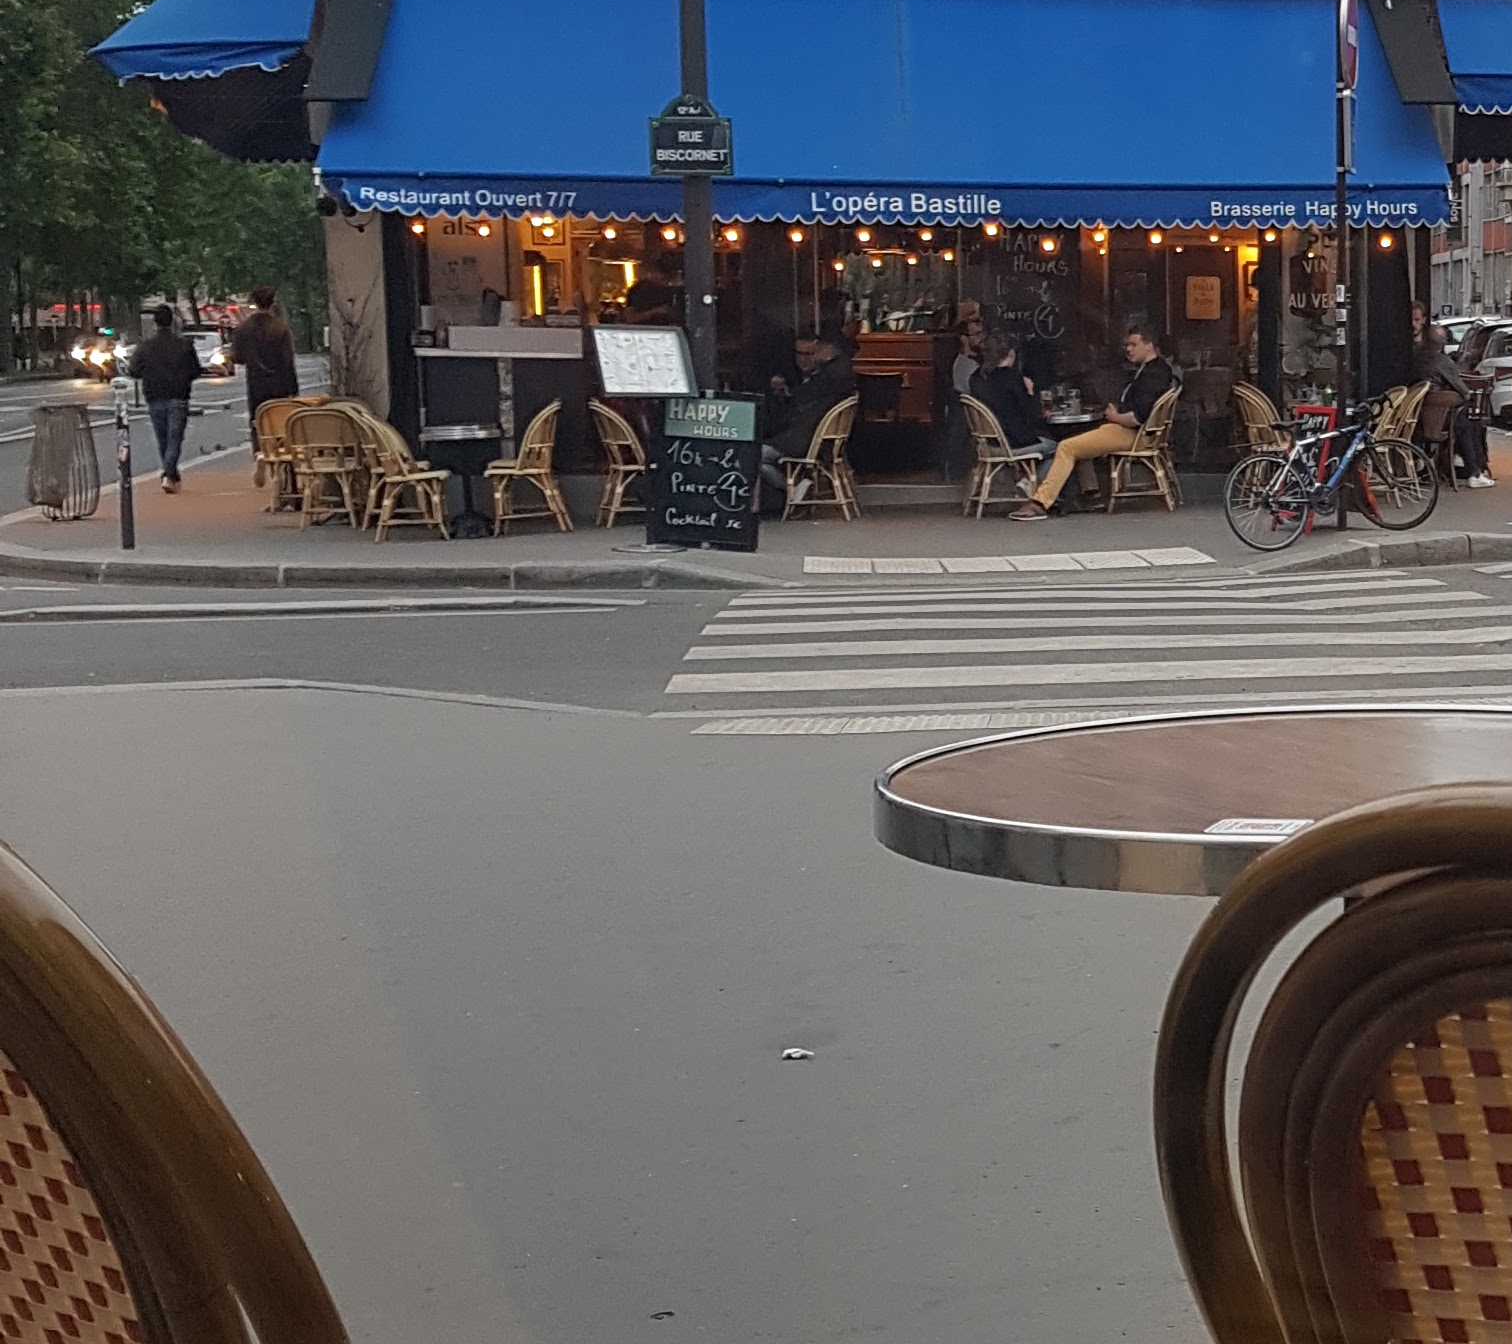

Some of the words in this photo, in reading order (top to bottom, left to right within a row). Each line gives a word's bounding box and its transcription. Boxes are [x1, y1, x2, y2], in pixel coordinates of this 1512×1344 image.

[678, 130, 704, 143] RUE
[656, 149, 729, 161] BISCORNET
[359, 186, 471, 206] Restaurant
[475, 189, 542, 207] Ouvert
[546, 191, 577, 207] 7/7
[811, 192, 903, 216] L'opéra
[910, 193, 1001, 215] Bastille
[1210, 201, 1296, 217] Brasserie
[1366, 200, 1417, 216] Hours
[1290, 293, 1305, 308] AU
[1311, 293, 1351, 309] VERE
[669, 398, 731, 423] HAPPY
[693, 425, 739, 438] HOURS
